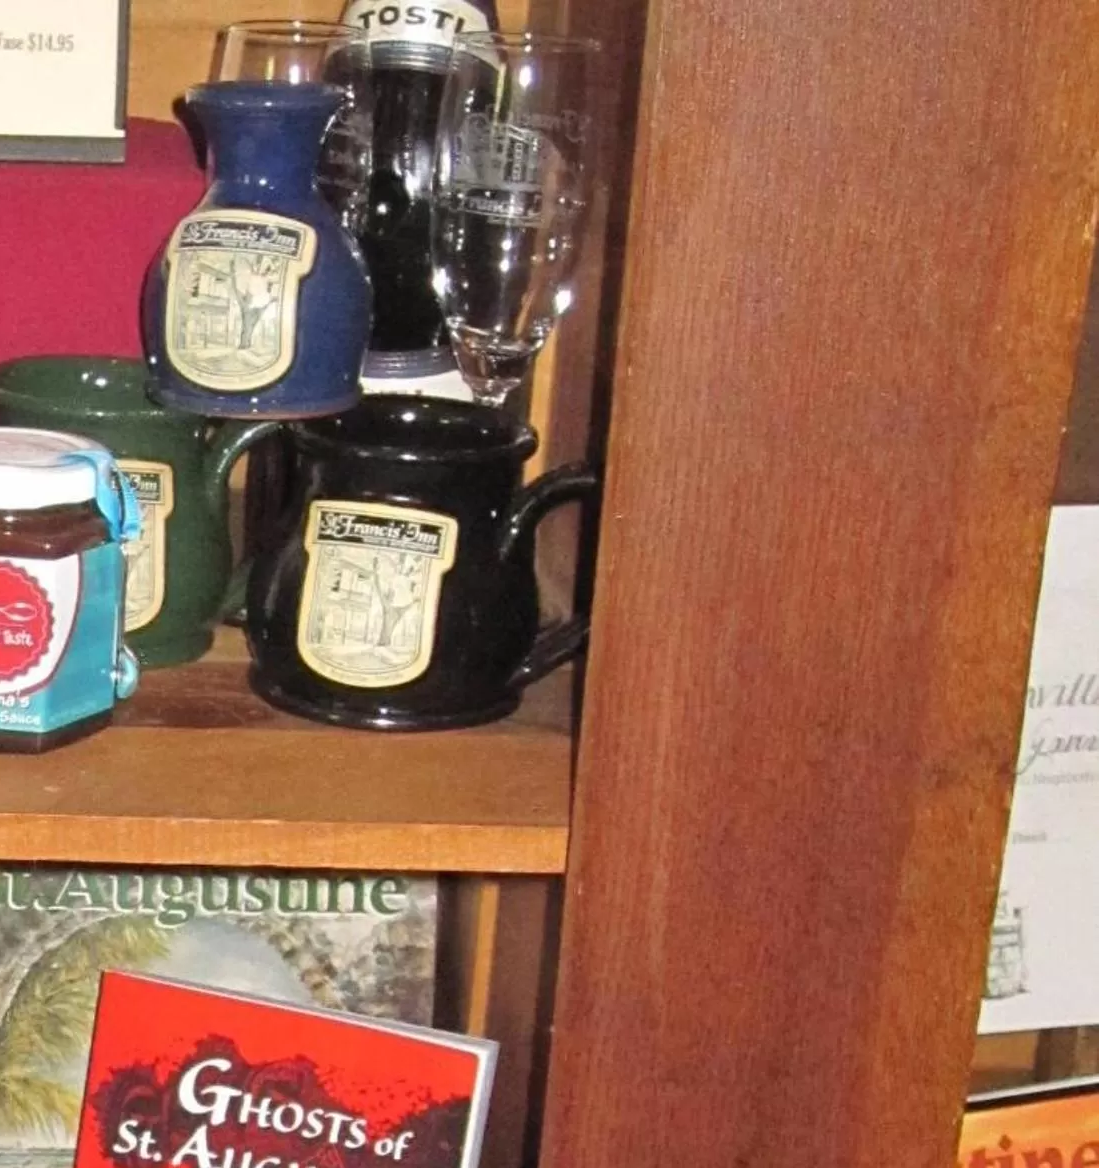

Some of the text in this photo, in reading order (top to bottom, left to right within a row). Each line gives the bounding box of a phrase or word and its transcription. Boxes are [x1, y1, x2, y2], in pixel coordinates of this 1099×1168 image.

[358, 5, 465, 33] TOSTI
[27, 32, 75, 52] $14.95
[336, 515, 403, 538] Francis
[405, 523, 439, 545] Inn
[0, 711, 41, 724] Sauce
[177, 1058, 415, 1160] GHOSTS of
[112, 1119, 162, 1162] St.
